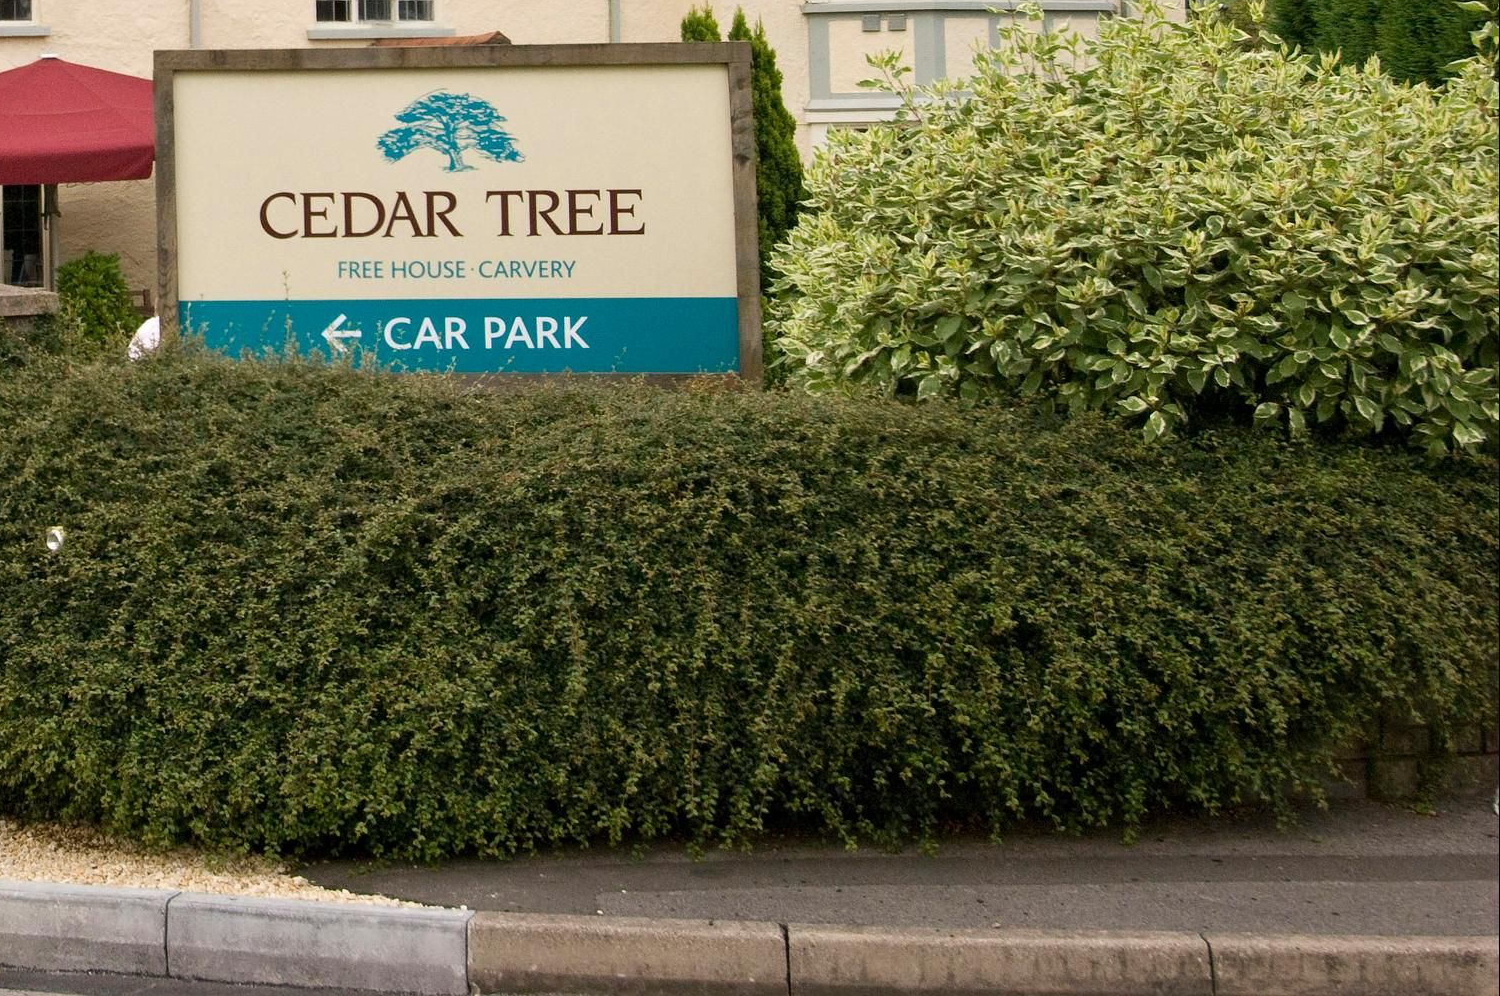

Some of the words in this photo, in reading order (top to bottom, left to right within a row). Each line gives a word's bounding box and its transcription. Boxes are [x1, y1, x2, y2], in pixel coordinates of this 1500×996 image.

[259, 191, 463, 240] CEDAR
[486, 188, 647, 237] TREE
[338, 260, 384, 279] FREE
[391, 260, 466, 279] HOUSE
[478, 260, 577, 279] CARVERY
[383, 316, 471, 351] CAR
[483, 316, 591, 350] PARK
